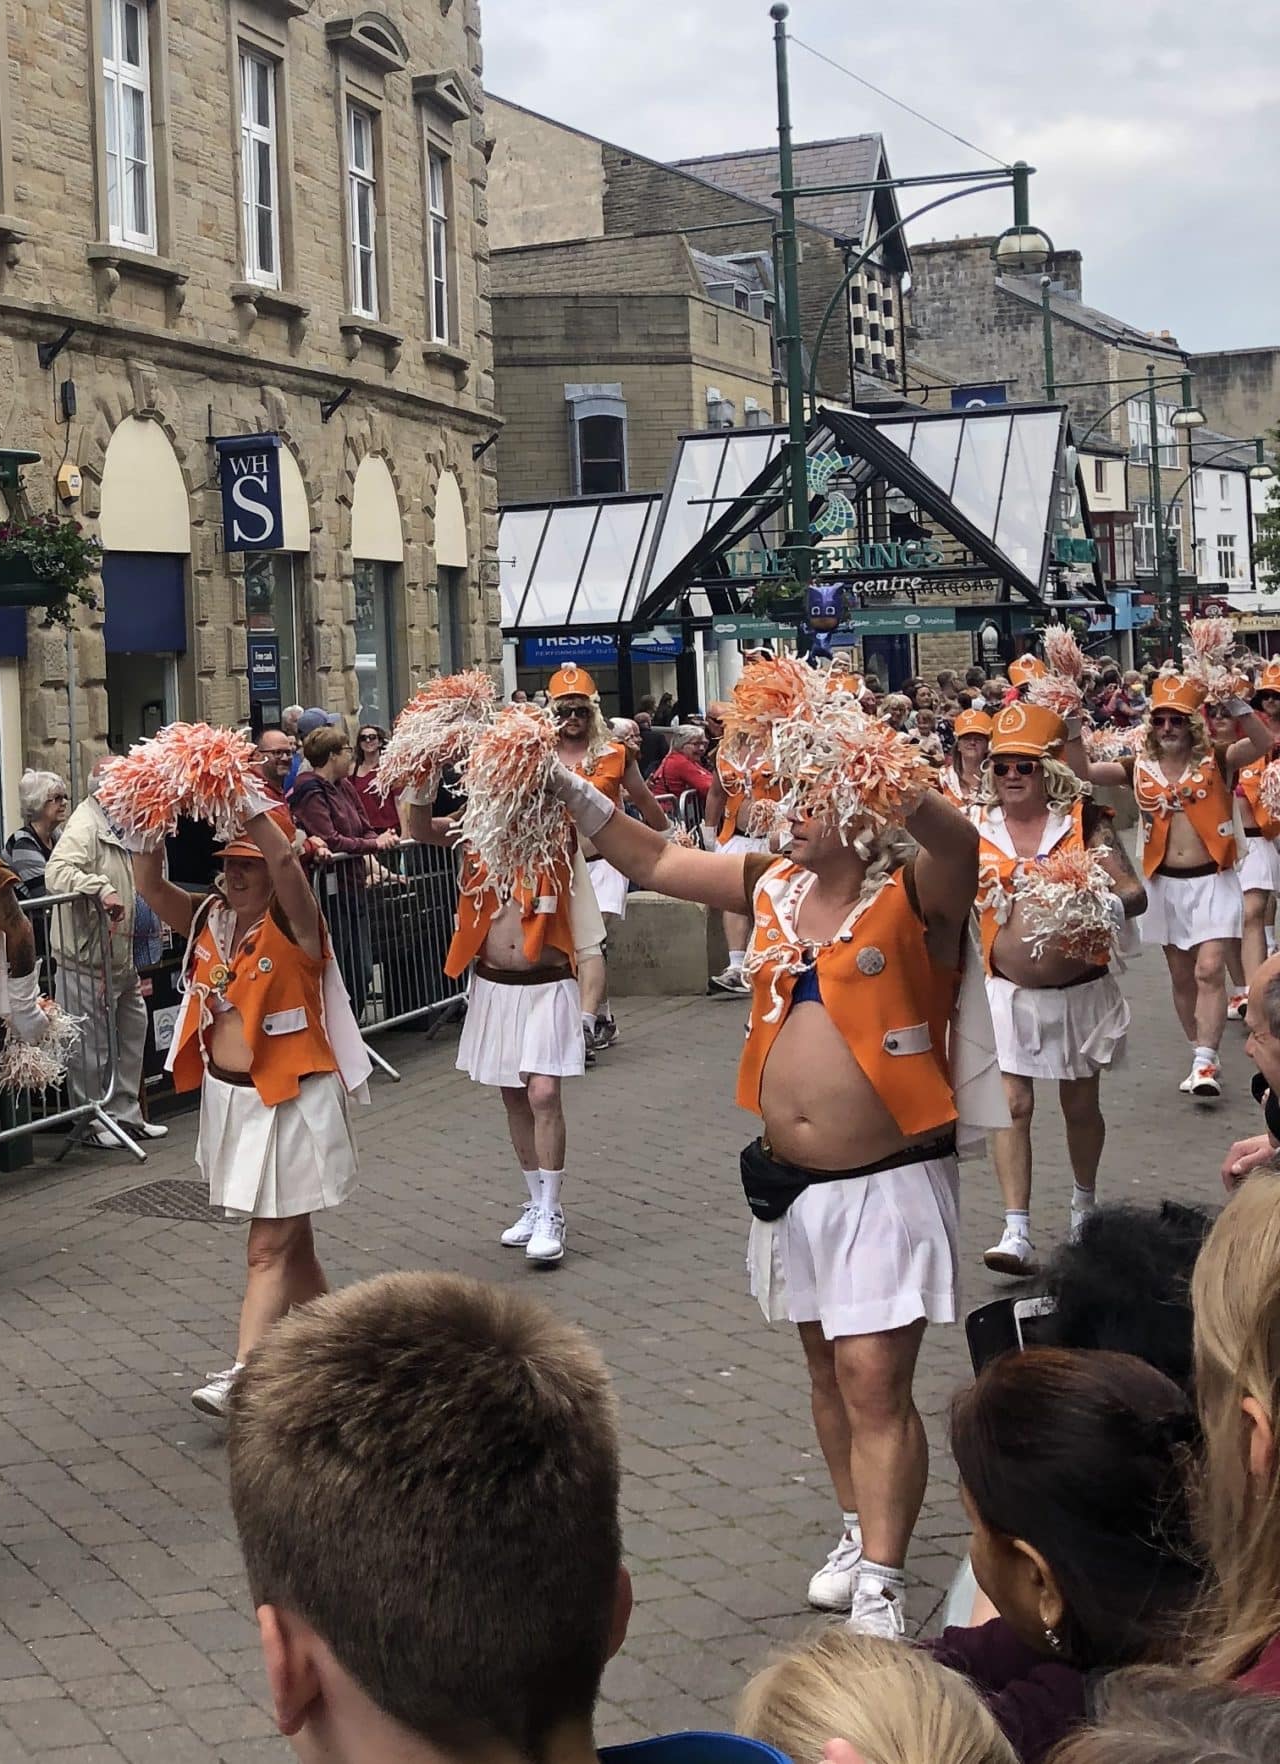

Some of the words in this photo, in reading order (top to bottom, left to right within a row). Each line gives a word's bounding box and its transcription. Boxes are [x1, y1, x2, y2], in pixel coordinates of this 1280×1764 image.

[228, 453, 270, 475] WH
[232, 475, 274, 542] S
[812, 538, 944, 574] PRINGS
[851, 576, 923, 594] centre
[537, 634, 620, 647] TRESPAS
